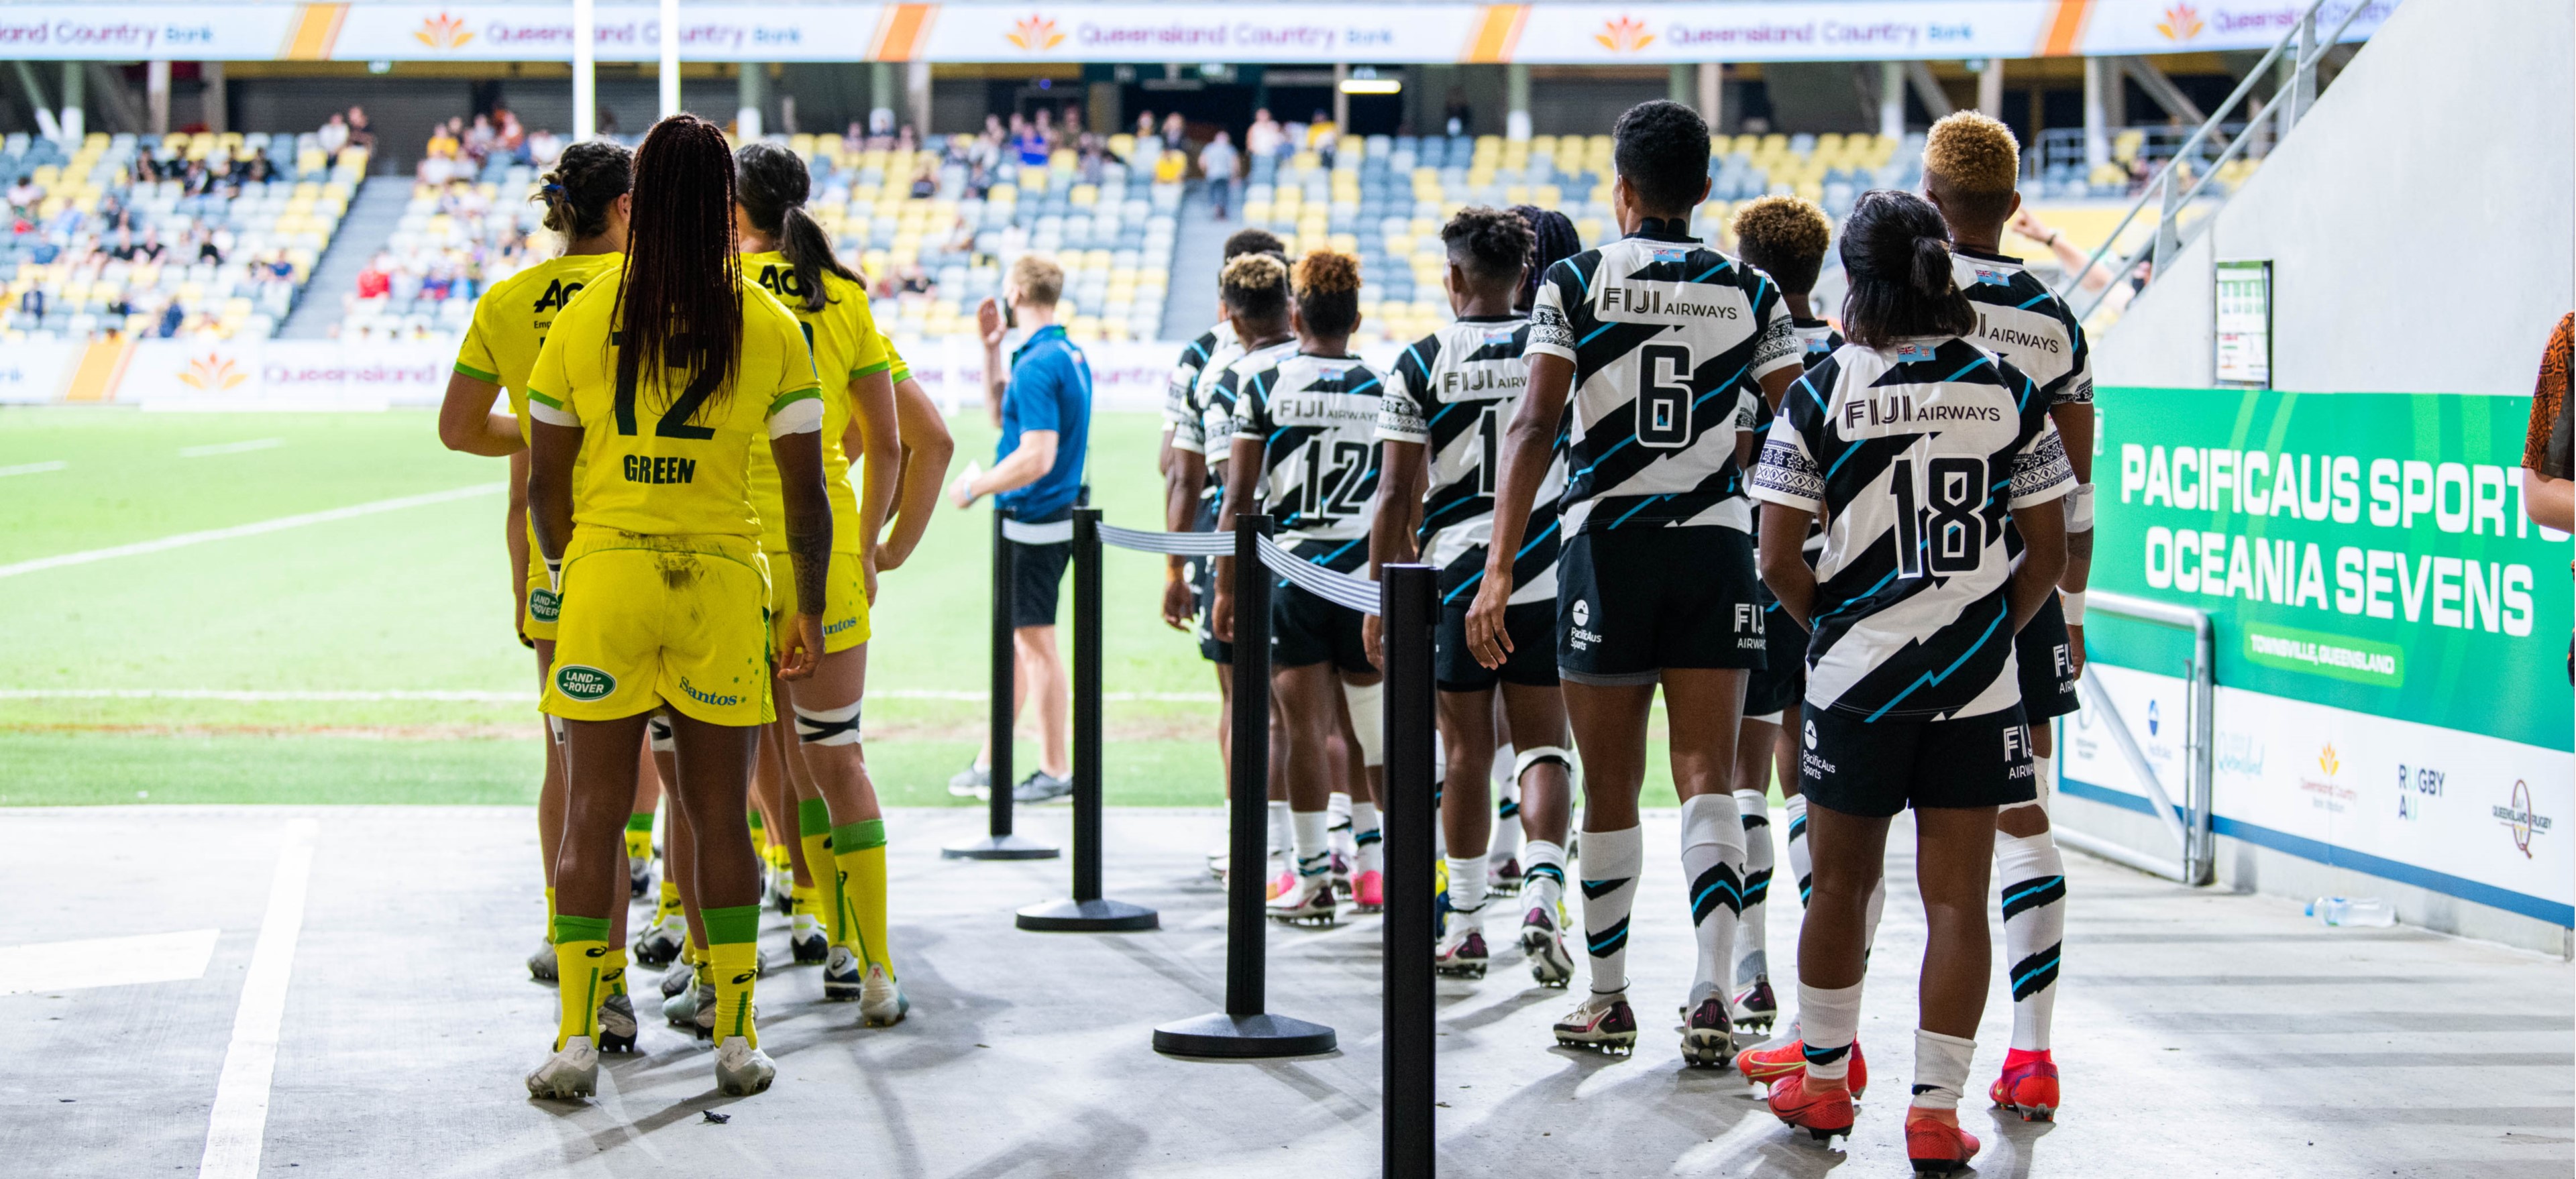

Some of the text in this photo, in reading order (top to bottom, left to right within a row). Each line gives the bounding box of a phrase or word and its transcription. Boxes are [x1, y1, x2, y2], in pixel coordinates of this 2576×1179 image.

[55, 22, 158, 52] Country
[1077, 23, 1228, 46] Queensland
[1233, 23, 1337, 53] Country
[1667, 23, 1815, 47] Queensland
[1821, 23, 1919, 50] Country
[1603, 288, 1737, 320] FIJI AIRWAYS
[1989, 327, 2059, 354] AIRWAYS
[262, 361, 438, 385] Queensland
[1444, 369, 1493, 394] FIJI
[1635, 341, 1695, 447] 6
[1279, 399, 1324, 418] FIJI
[1845, 395, 2000, 429] FIJI AIRWAYS
[623, 454, 696, 484] GREEN
[1300, 436, 1370, 518] 12
[2121, 443, 2571, 543] PACIFICAUS SPORT
[1889, 453, 1988, 579] 18
[2145, 526, 2534, 637] OCEANIA SEVENS
[533, 593, 551, 606] LAND
[535, 604, 559, 616] ROVER
[1734, 603, 1765, 634] FIJ
[1570, 626, 1602, 642] PacificAus
[1570, 636, 1587, 651] Sports
[2250, 633, 2396, 675] TOWNSVILLE, QUEENSLAND
[566, 671, 594, 683] LAND
[569, 681, 604, 693] ROVER
[680, 676, 737, 706] Santos
[2003, 723, 2033, 763] FIJ
[1803, 749, 1836, 773] PacificAus
[1803, 761, 1821, 780] Sports
[2399, 764, 2446, 797] RUGBY
[2399, 795, 2418, 822] AU
[2492, 804, 2553, 831] QUEENSLAND RUGBY
